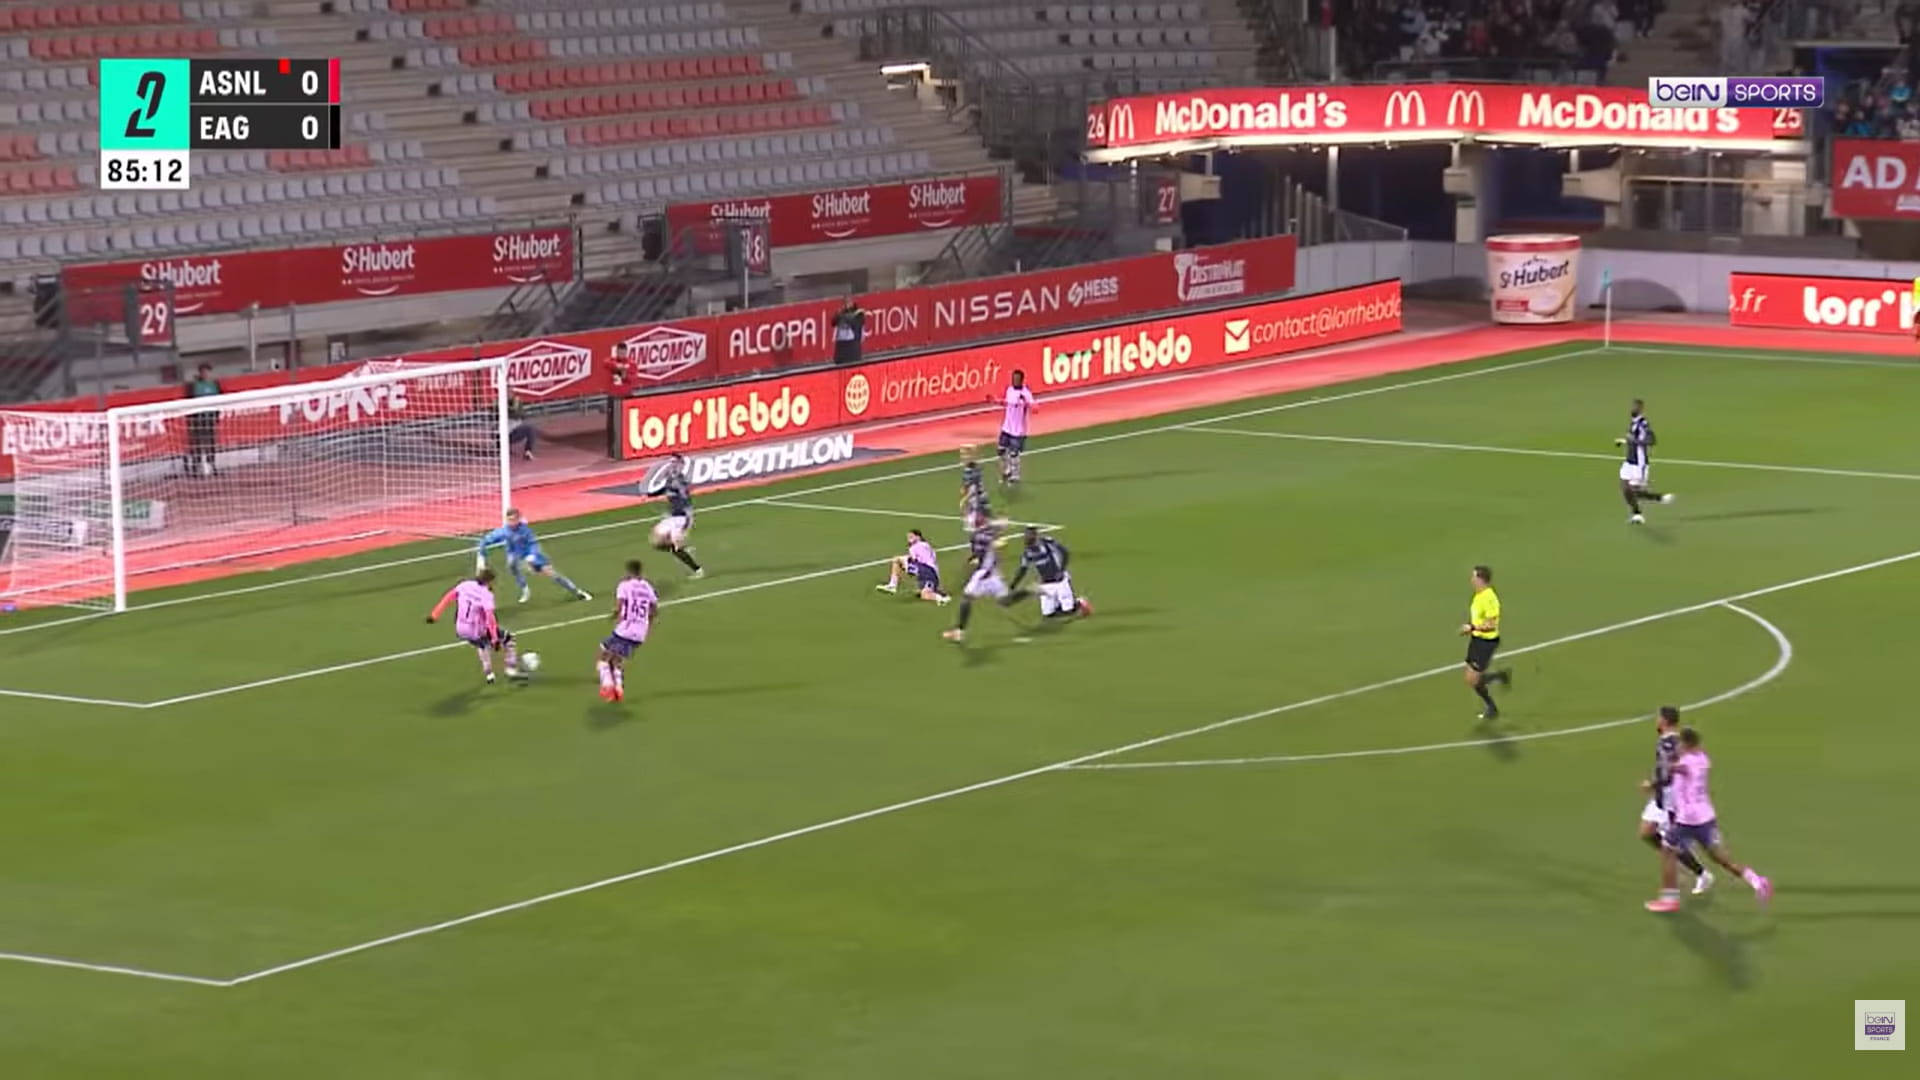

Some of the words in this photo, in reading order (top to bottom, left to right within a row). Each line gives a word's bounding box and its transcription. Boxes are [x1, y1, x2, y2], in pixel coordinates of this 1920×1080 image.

[1087, 113, 1106, 139] 26
[1155, 93, 1347, 135] McDonald's
[1518, 93, 1739, 133] McDonalds
[1773, 107, 1801, 129] 25
[824, 191, 871, 217] Hubert
[922, 182, 966, 207] Hubert
[1158, 186, 1176, 212] 27
[359, 244, 416, 272] Hubert
[509, 233, 561, 260] Hubert
[1084, 276, 1118, 298] HESS
[1513, 260, 1569, 287] Hubert
[140, 303, 168, 335] 29
[935, 284, 1060, 328] NISSAN
[729, 317, 817, 358] ALCOPA
[862, 304, 918, 337] CTION
[630, 337, 704, 366] ANCOMCY
[496, 351, 588, 384] ANCOMCY
[881, 359, 1002, 404] lorrhebdo.fr
[3, 414, 166, 454] EUROMATER
[692, 432, 854, 484] DECATHLON
[631, 600, 648, 619] 45
